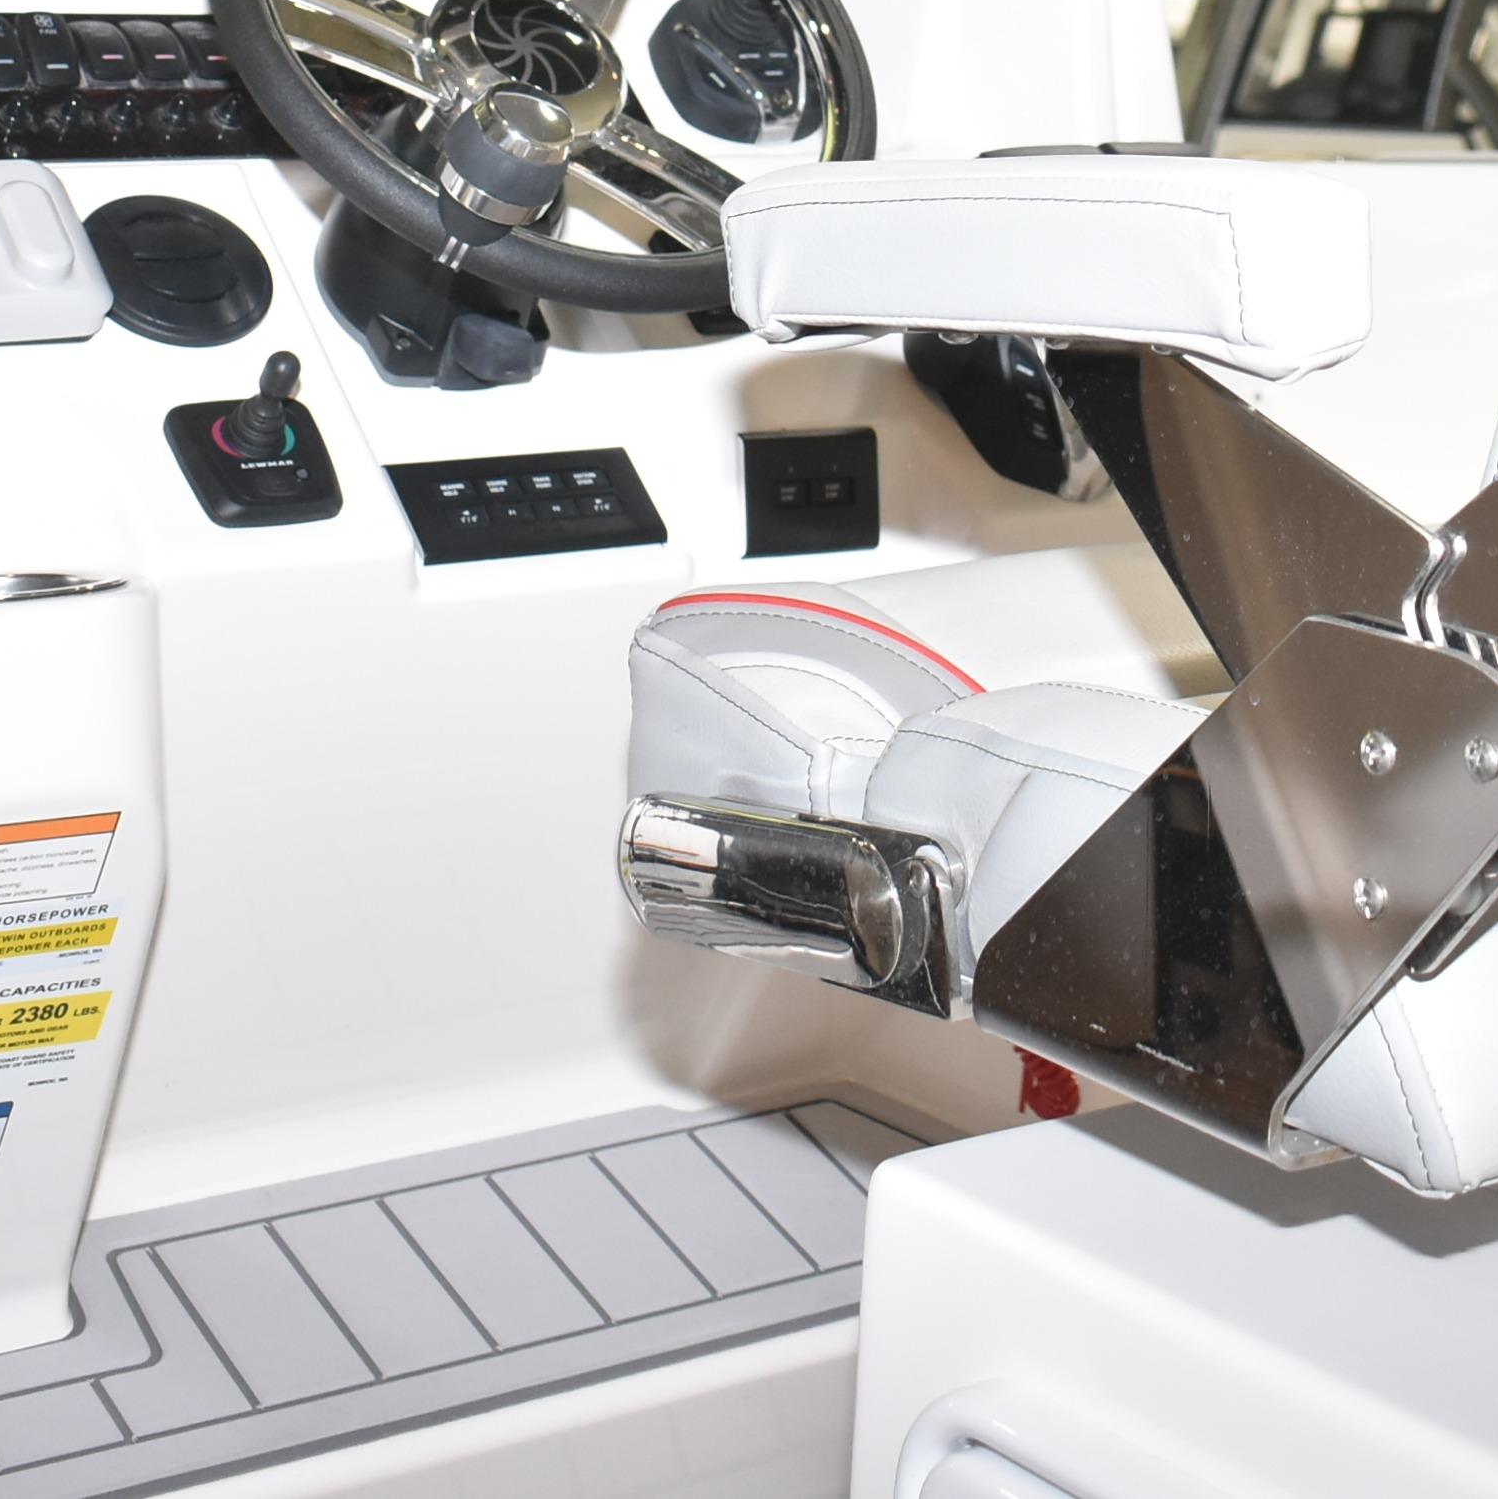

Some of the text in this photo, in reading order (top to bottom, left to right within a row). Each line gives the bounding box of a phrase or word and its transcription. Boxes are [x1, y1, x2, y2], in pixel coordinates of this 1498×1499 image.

[240, 459, 294, 470] LEWMAR
[30, 922, 107, 939] OUTBOARDS
[55, 937, 89, 947] EACH
[0, 977, 101, 999] CAPACITIES
[9, 1003, 69, 1025] 2380
[73, 1006, 101, 1017] LBS.
